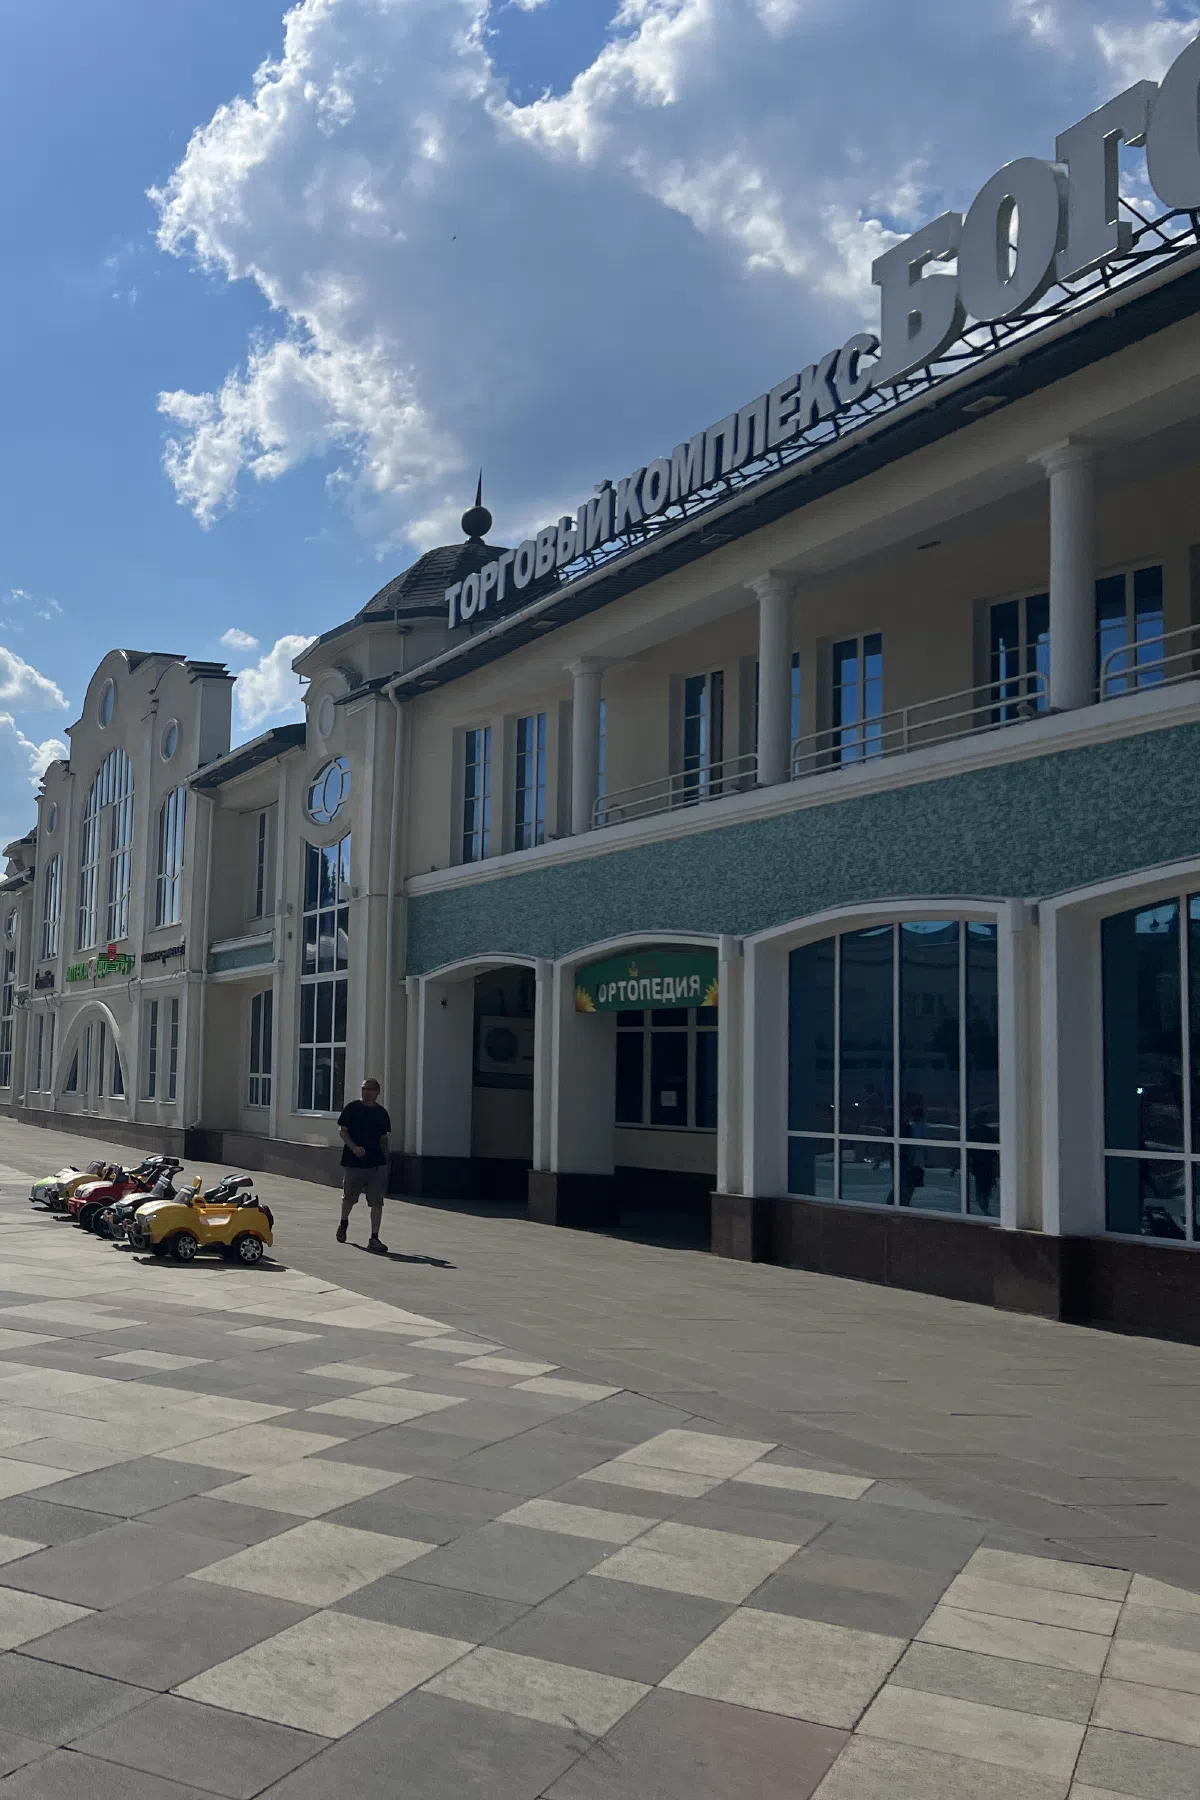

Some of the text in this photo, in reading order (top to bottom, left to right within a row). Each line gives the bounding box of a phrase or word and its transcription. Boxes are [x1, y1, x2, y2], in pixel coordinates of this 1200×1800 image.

[445, 479, 616, 629] ТОРГОВЫЙ
[617, 332, 880, 534] КОМПЛЕКС
[66, 962, 89, 982] АПТЕКА
[597, 975, 701, 1004] ОРТОПЕДИЯ
